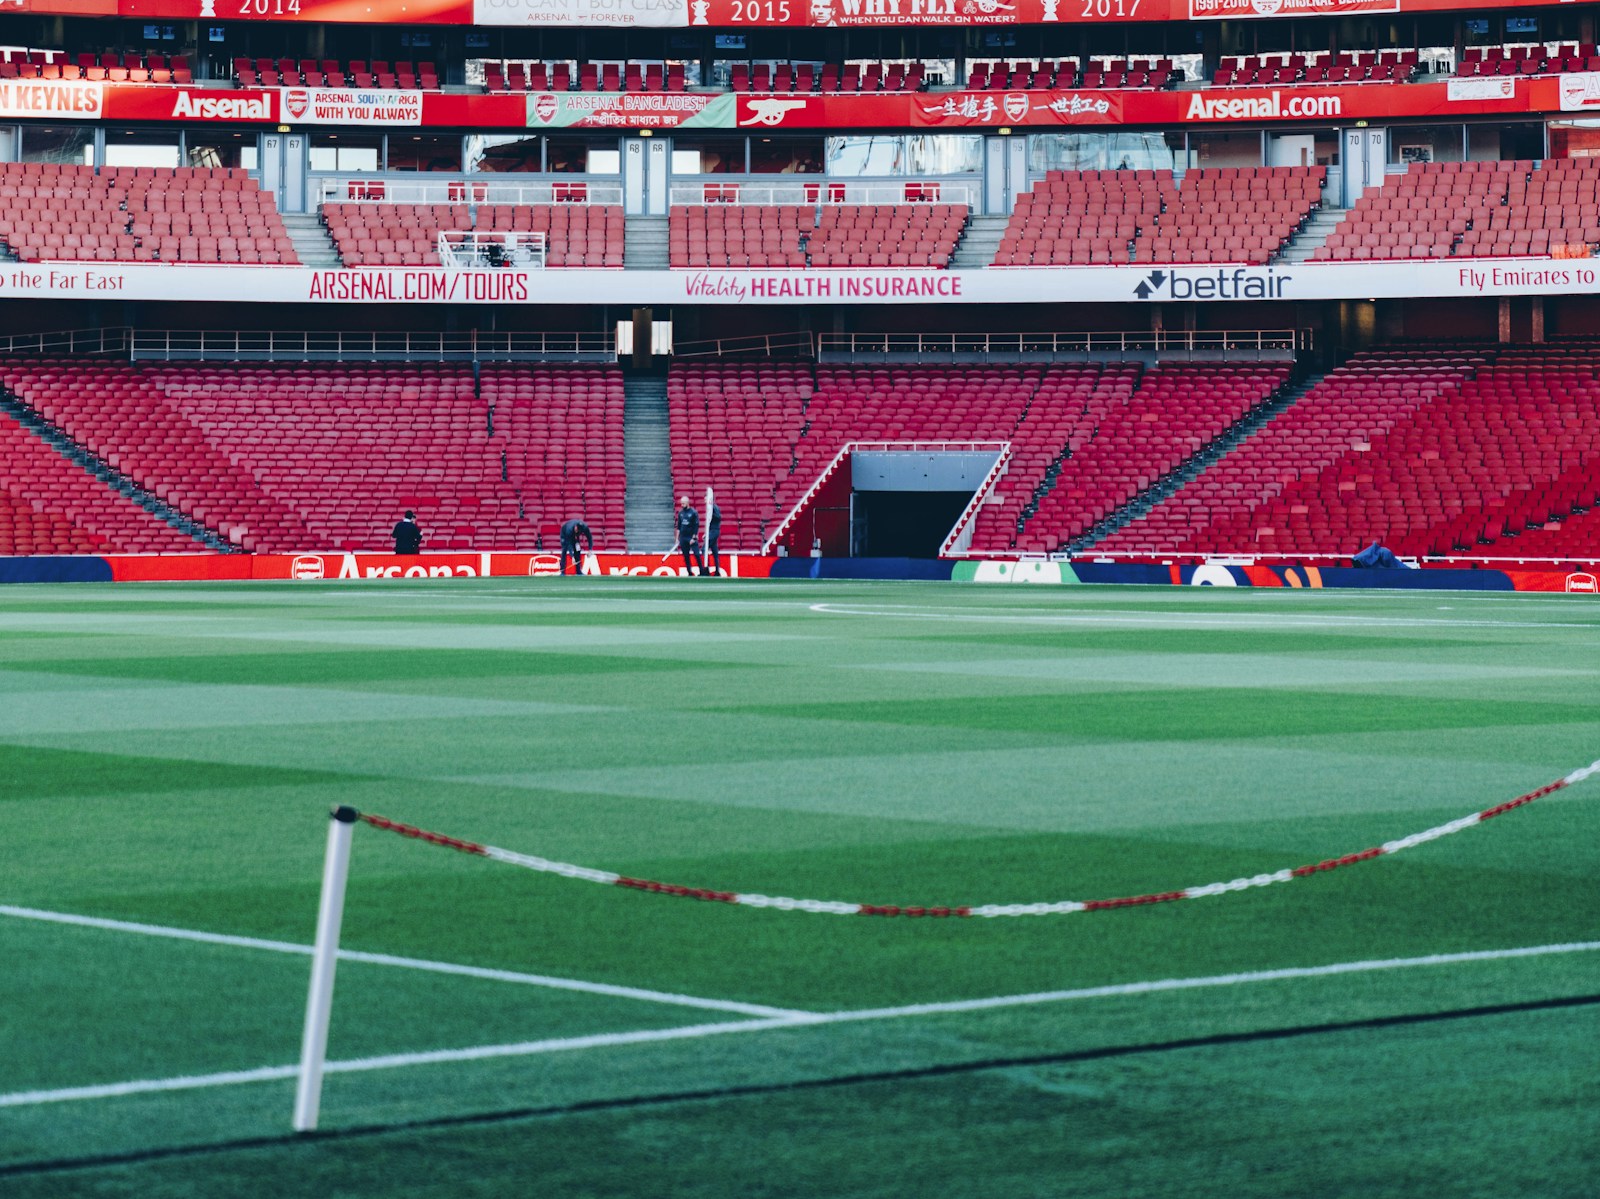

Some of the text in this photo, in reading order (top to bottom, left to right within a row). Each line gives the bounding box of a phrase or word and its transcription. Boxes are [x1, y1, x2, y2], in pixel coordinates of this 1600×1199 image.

[527, 13, 635, 23] ARSENAL FOREVER
[731, 0, 791, 22] 2015
[840, 16, 872, 24] WHEN
[921, 15, 951, 23] WALK
[955, 15, 971, 23] ON
[974, 15, 1016, 23] WATER?
[16, 85, 99, 112] KEYNES
[172, 91, 271, 119] Arsenal
[315, 93, 354, 104] ARSENAL
[566, 95, 707, 111] ARSENAL BANGLADESH
[1186, 91, 1341, 119] Arsenal.com
[315, 106, 419, 120] WITH YOU ALWAYS
[267, 140, 277, 149] 67
[289, 140, 300, 149] 67
[1349, 135, 1360, 145] 70
[1372, 134, 1382, 145] 70
[629, 143, 640, 153] 68
[11, 270, 42, 289] the
[50, 271, 78, 289] Far
[85, 271, 125, 290] East
[309, 272, 528, 300] ARSENAL.COM/TOURS
[1170, 268, 1293, 299] betfair
[1459, 267, 1595, 291] Fly Emirates to
[685, 272, 962, 303] Vitality HEALTH INSURANCE
